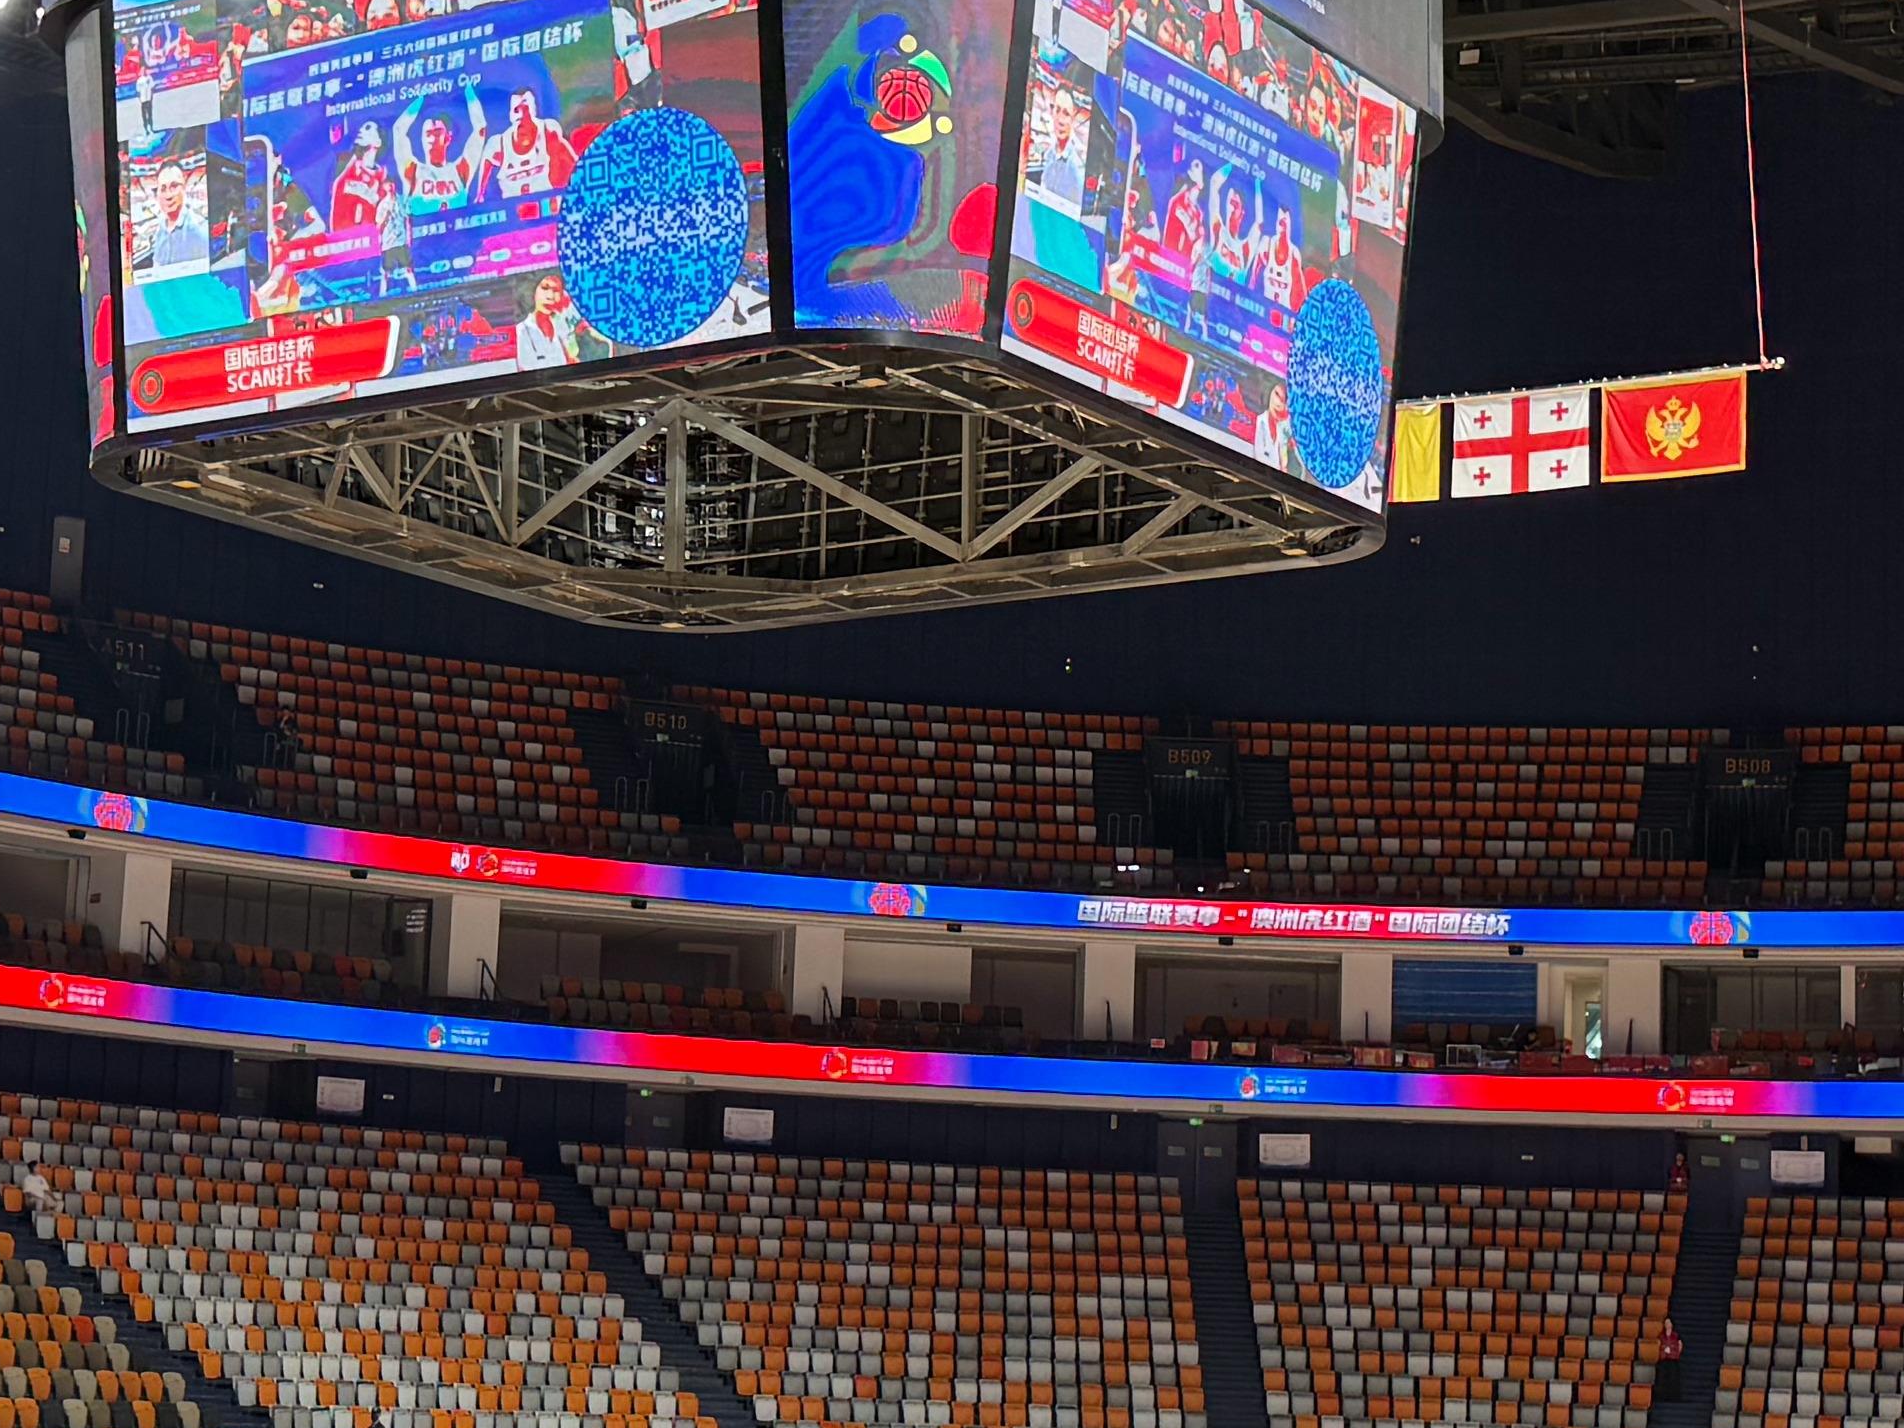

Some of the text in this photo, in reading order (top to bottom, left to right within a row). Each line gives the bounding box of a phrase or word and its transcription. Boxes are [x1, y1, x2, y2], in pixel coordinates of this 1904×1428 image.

[326, 89, 396, 117] International
[1078, 309, 1140, 358] 国际团结杯
[223, 335, 315, 372] 国际团结杯
[226, 367, 313, 394] SCAN打卡
[645, 712, 687, 730] B510
[1168, 749, 1213, 765] B509
